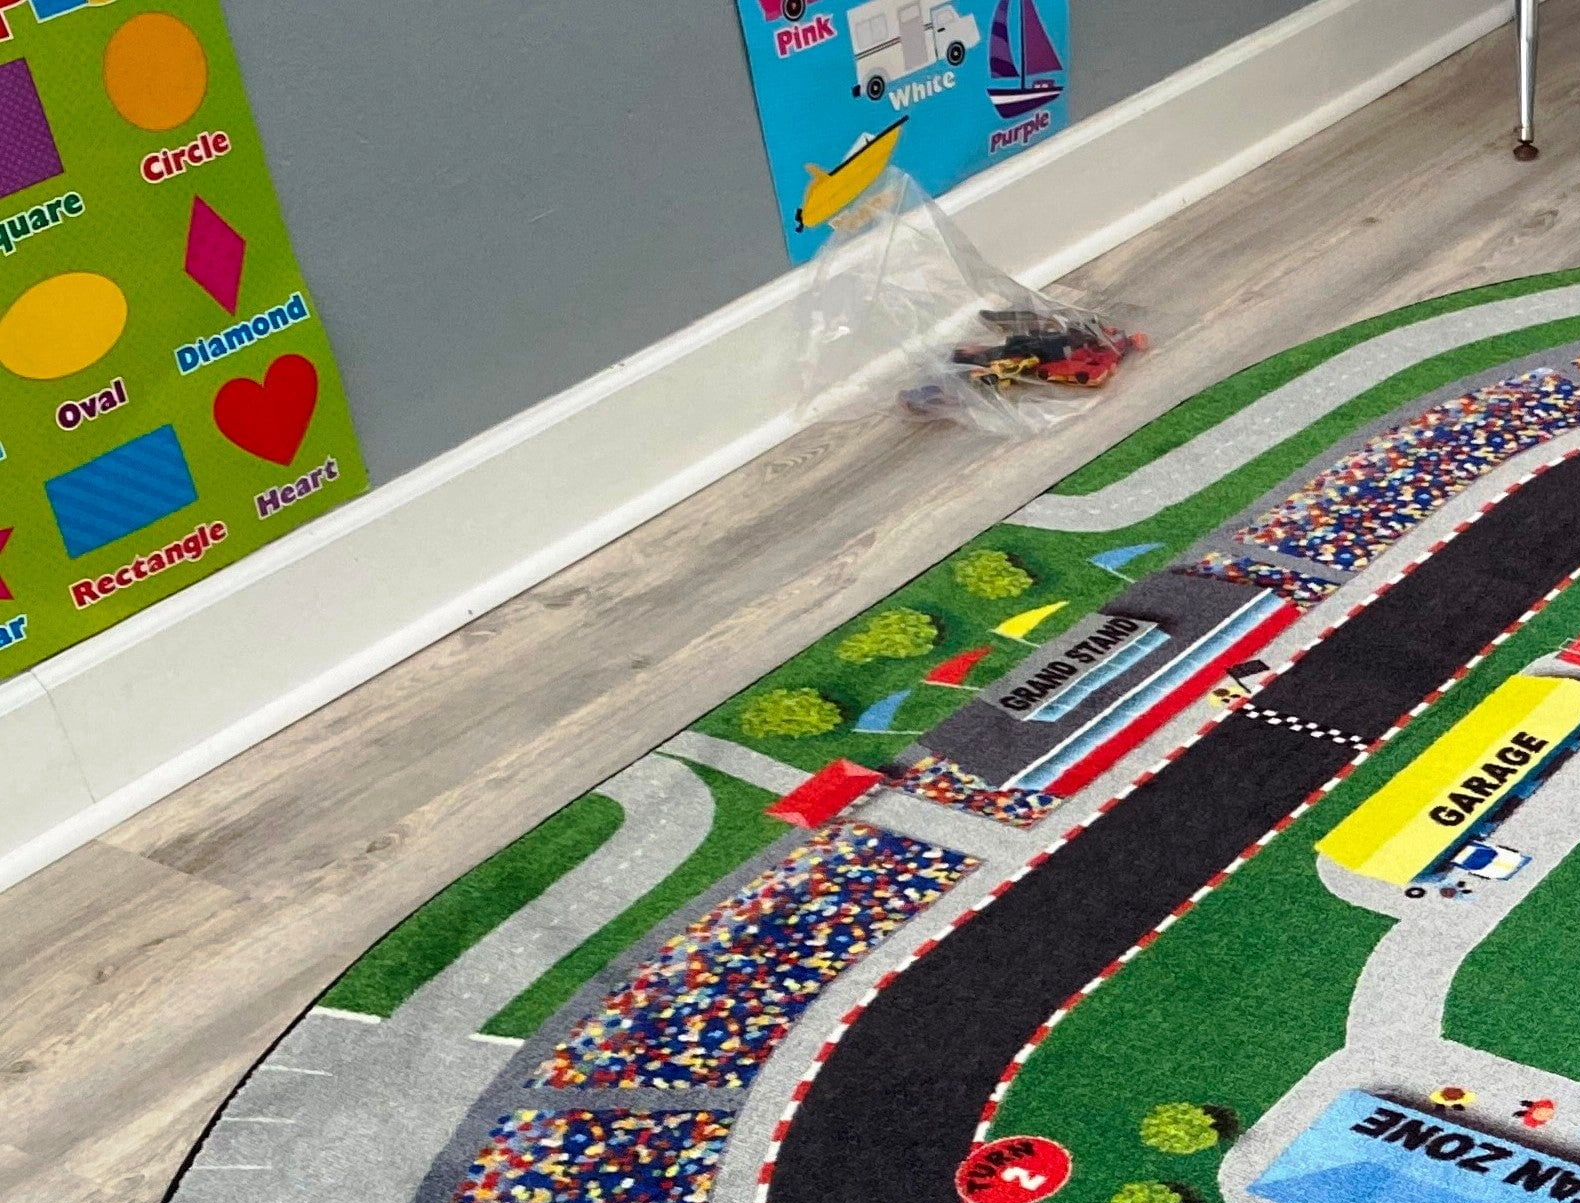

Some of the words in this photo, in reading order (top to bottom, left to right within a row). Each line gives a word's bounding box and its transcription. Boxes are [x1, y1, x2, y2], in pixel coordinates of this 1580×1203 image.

[774, 15, 837, 58] Pink
[888, 70, 957, 111] White
[141, 131, 231, 184] Circle
[989, 110, 1050, 154] Purple
[174, 293, 310, 375] Diamond
[56, 377, 128, 432] Oval
[256, 457, 340, 518] Heart
[70, 520, 227, 609] Rectangle
[1000, 658, 1077, 711] GRAND
[1065, 616, 1139, 664] STAND
[1428, 731, 1549, 828] GARAGE
[966, 1141, 1035, 1195] TURN
[1001, 1166, 1048, 1191] 2
[1349, 1107, 1514, 1175] ZONE
